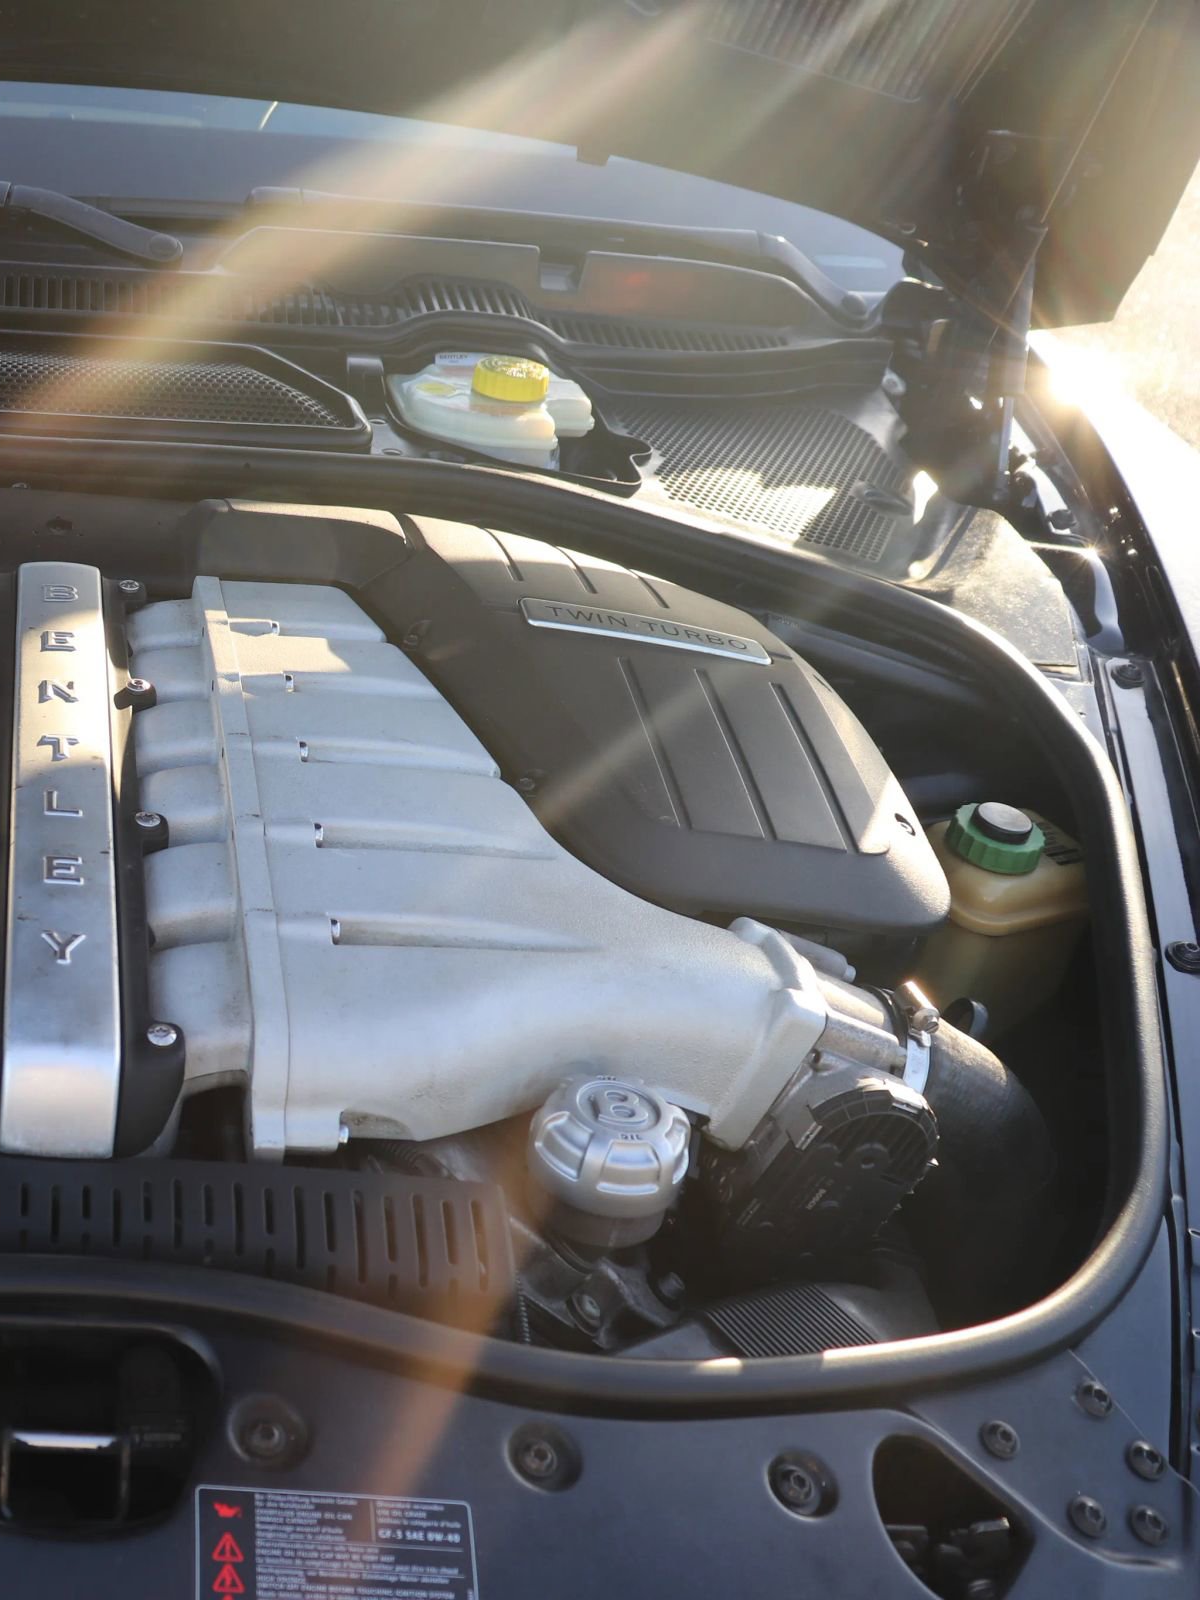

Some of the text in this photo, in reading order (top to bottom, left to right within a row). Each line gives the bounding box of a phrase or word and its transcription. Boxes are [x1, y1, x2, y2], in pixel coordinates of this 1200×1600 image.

[544, 605, 629, 628] TWIN
[639, 620, 748, 651] TURBO
[37, 583, 87, 966] BENTLEY
